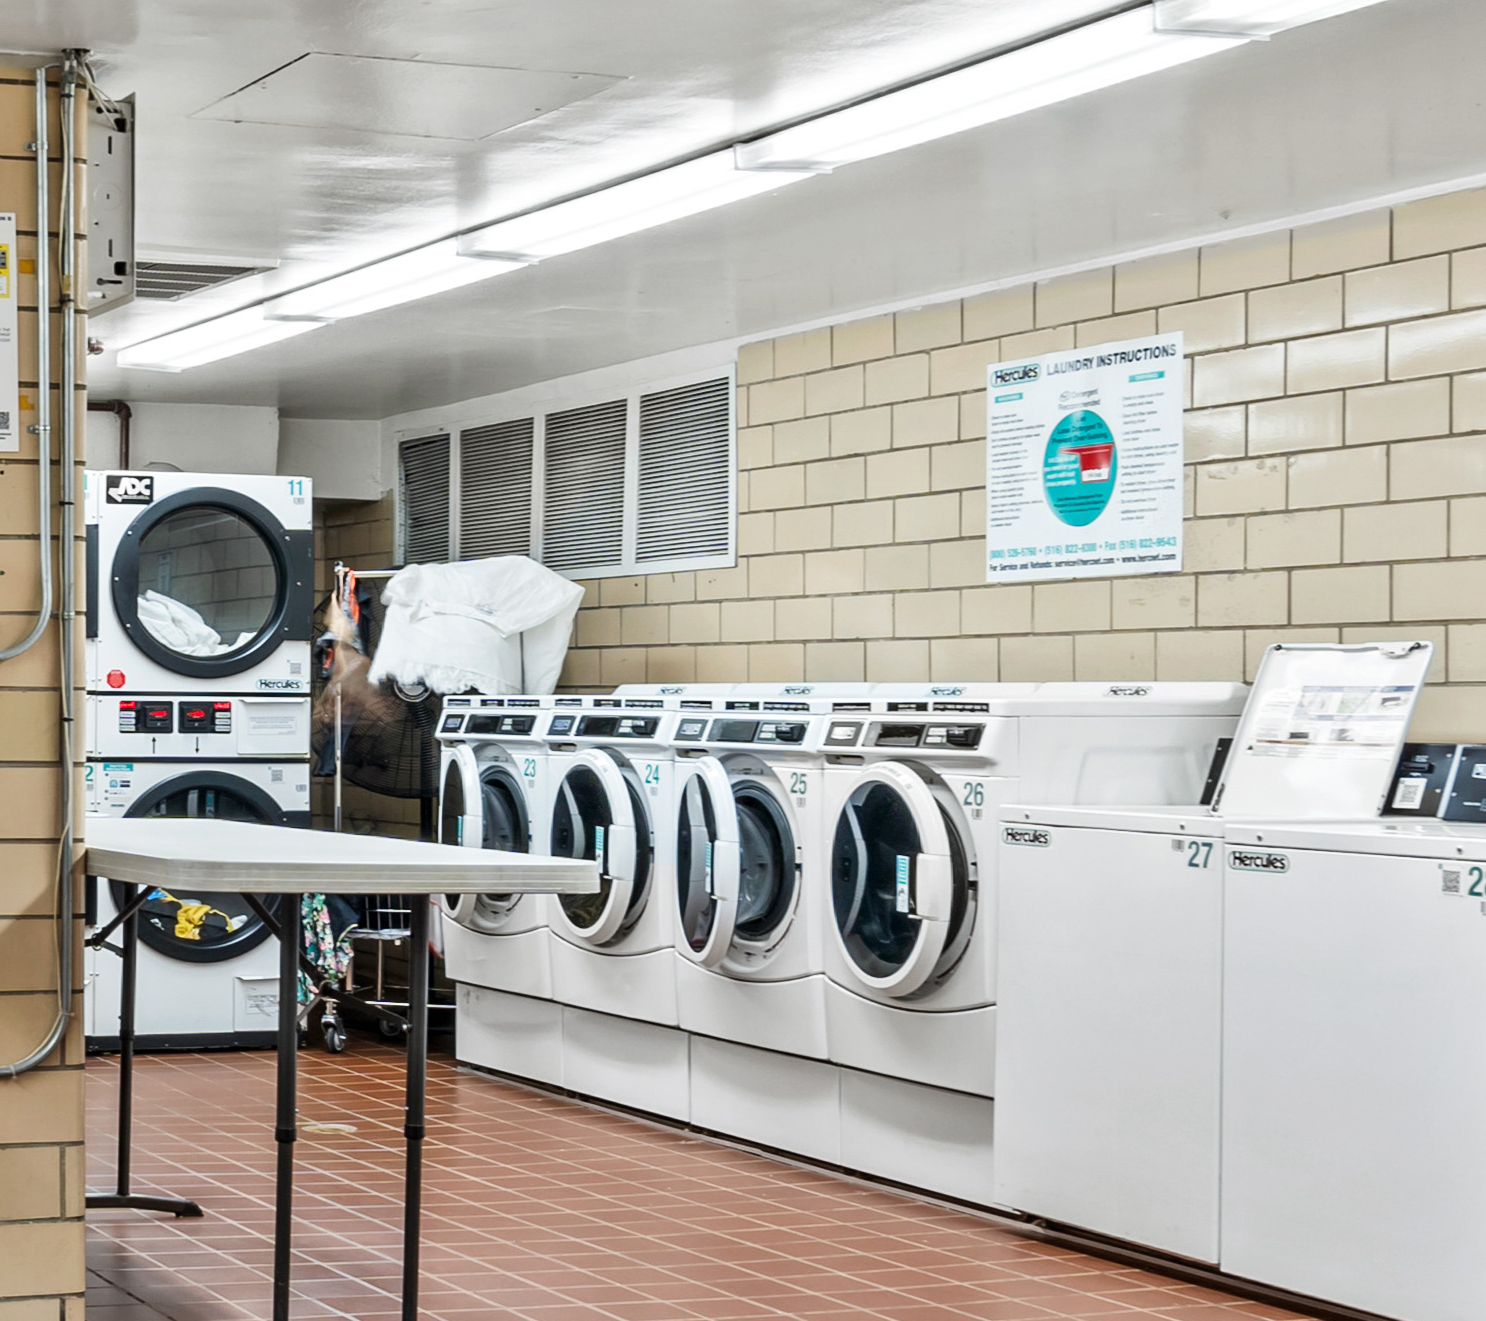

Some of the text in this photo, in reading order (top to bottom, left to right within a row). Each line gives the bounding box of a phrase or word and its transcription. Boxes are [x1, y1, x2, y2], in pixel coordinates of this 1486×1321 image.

[1047, 344, 1177, 376] LAUNDRY INSTRUCTIONS
[995, 366, 1038, 384] Hercules
[118, 477, 151, 496] ADC
[288, 480, 303, 496] 11
[999, 563, 1018, 571] Service
[259, 679, 300, 689] Hercules
[1109, 686, 1147, 696] Hercules
[524, 758, 536, 777] 23
[645, 764, 659, 784] 24
[791, 772, 807, 794] 25
[964, 782, 983, 806] 26
[1006, 829, 1048, 844] Hercules
[1188, 841, 1213, 868] 27
[1232, 852, 1285, 869] Hercules
